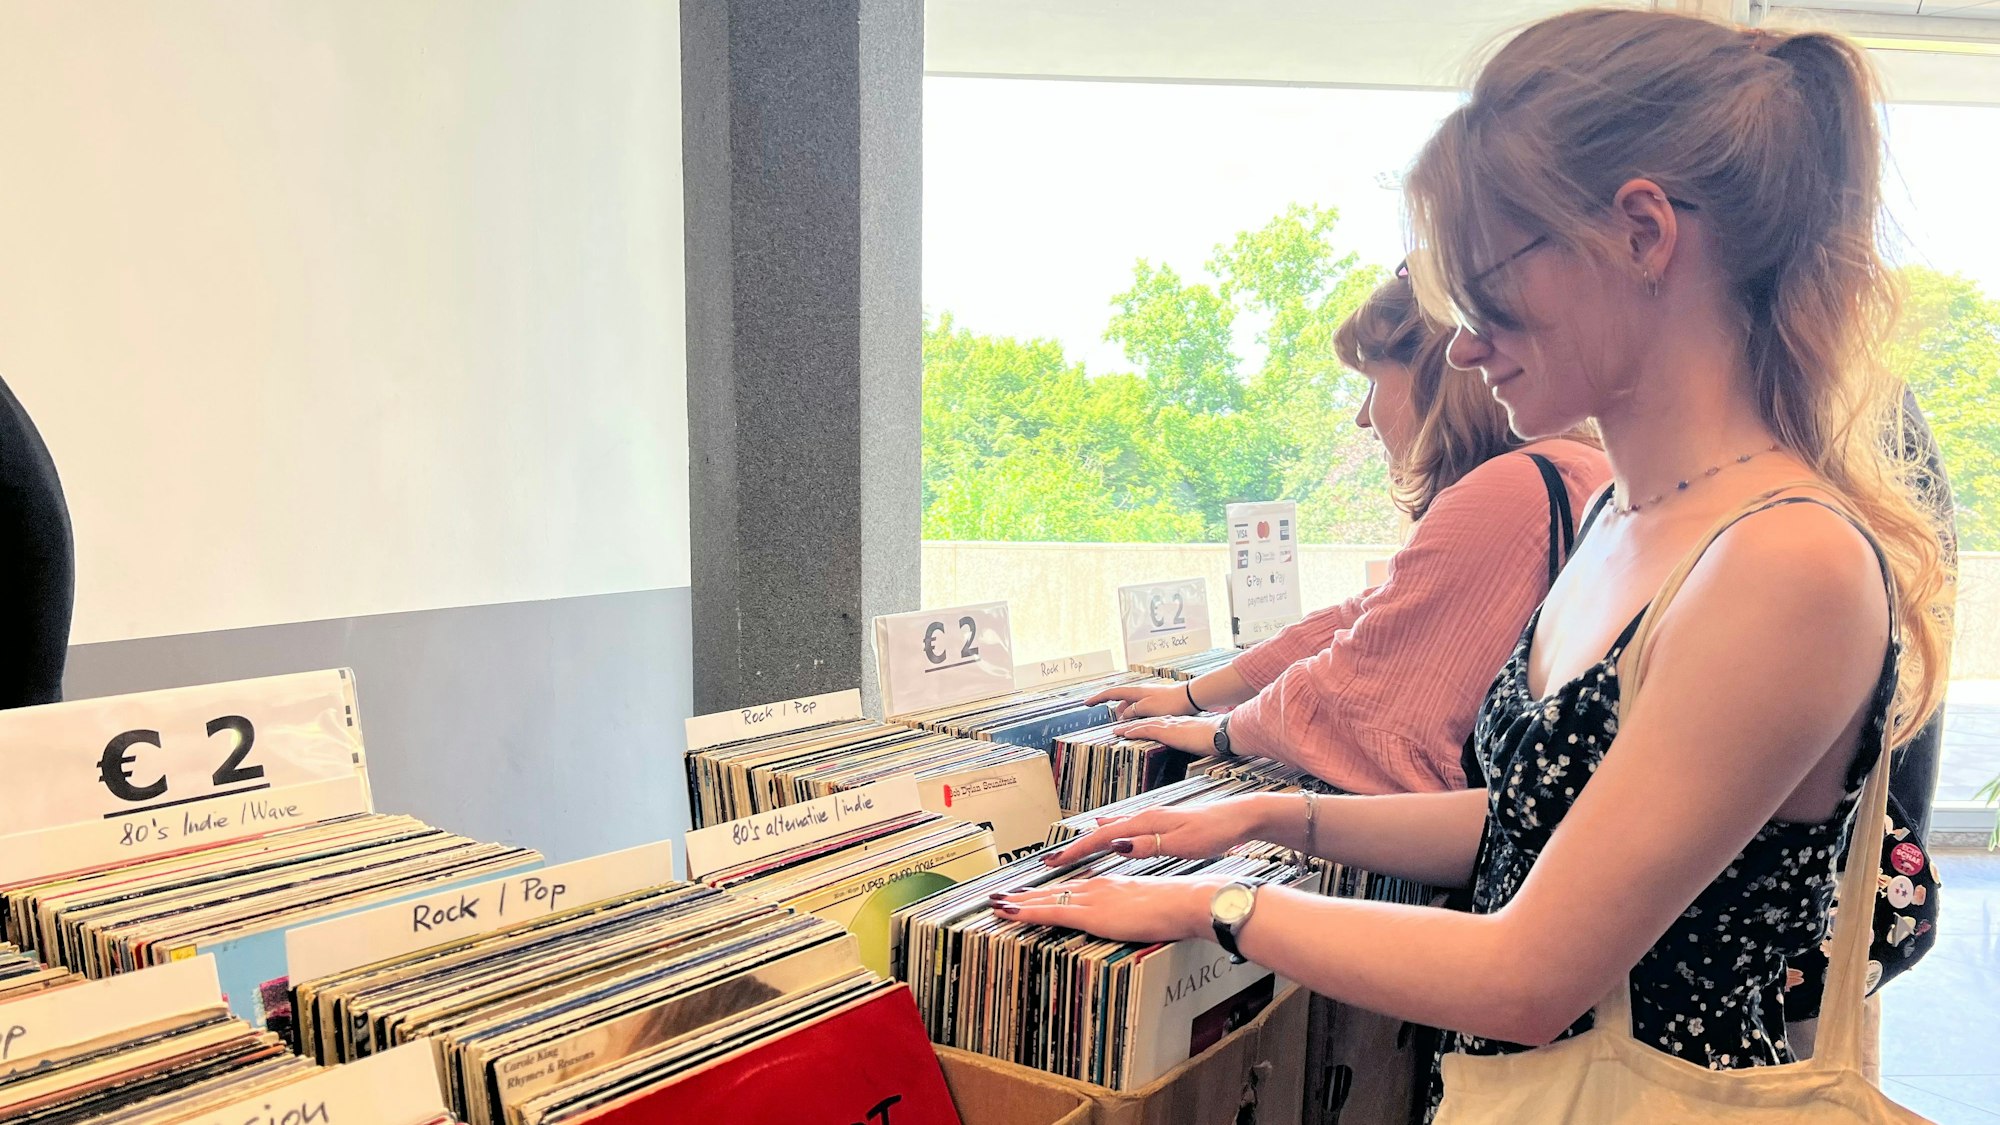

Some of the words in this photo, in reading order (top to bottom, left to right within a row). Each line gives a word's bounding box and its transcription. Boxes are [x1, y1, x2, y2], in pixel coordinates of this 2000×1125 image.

[1237, 528, 1248, 539] VISA
[1150, 594, 1164, 627] €
[1173, 592, 1185, 625] 2
[1248, 595, 1268, 608] payment
[1269, 593, 1275, 604] by
[1276, 591, 1287, 601] card
[923, 621, 947, 664] €
[959, 616, 979, 658] 2
[1171, 635, 1189, 646] Rock
[1040, 662, 1059, 677] Rock
[1069, 657, 1083, 673] Pop
[741, 705, 773, 725] Rock
[794, 701, 817, 715] Pop
[97, 729, 168, 802] €
[206, 715, 265, 787] 2
[961, 784, 981, 797] Dylan
[983, 776, 1018, 791] Soundtrack
[120, 817, 169, 846] 80's
[183, 811, 230, 837] Indie
[732, 819, 760, 846] 80's
[766, 806, 829, 836] alternative
[842, 793, 874, 816] indie
[860, 877, 885, 895] SUPER
[888, 867, 913, 885] SOUND
[914, 858, 935, 875] SINGLE
[413, 894, 480, 932] Rock
[520, 877, 566, 911] Pop
[1164, 956, 1233, 1008] MARC
[503, 1055, 535, 1074] Carole
[537, 1047, 559, 1062] King
[507, 1069, 545, 1089] Rhymes
[547, 1062, 555, 1074] &
[557, 1050, 595, 1070] Reasons
